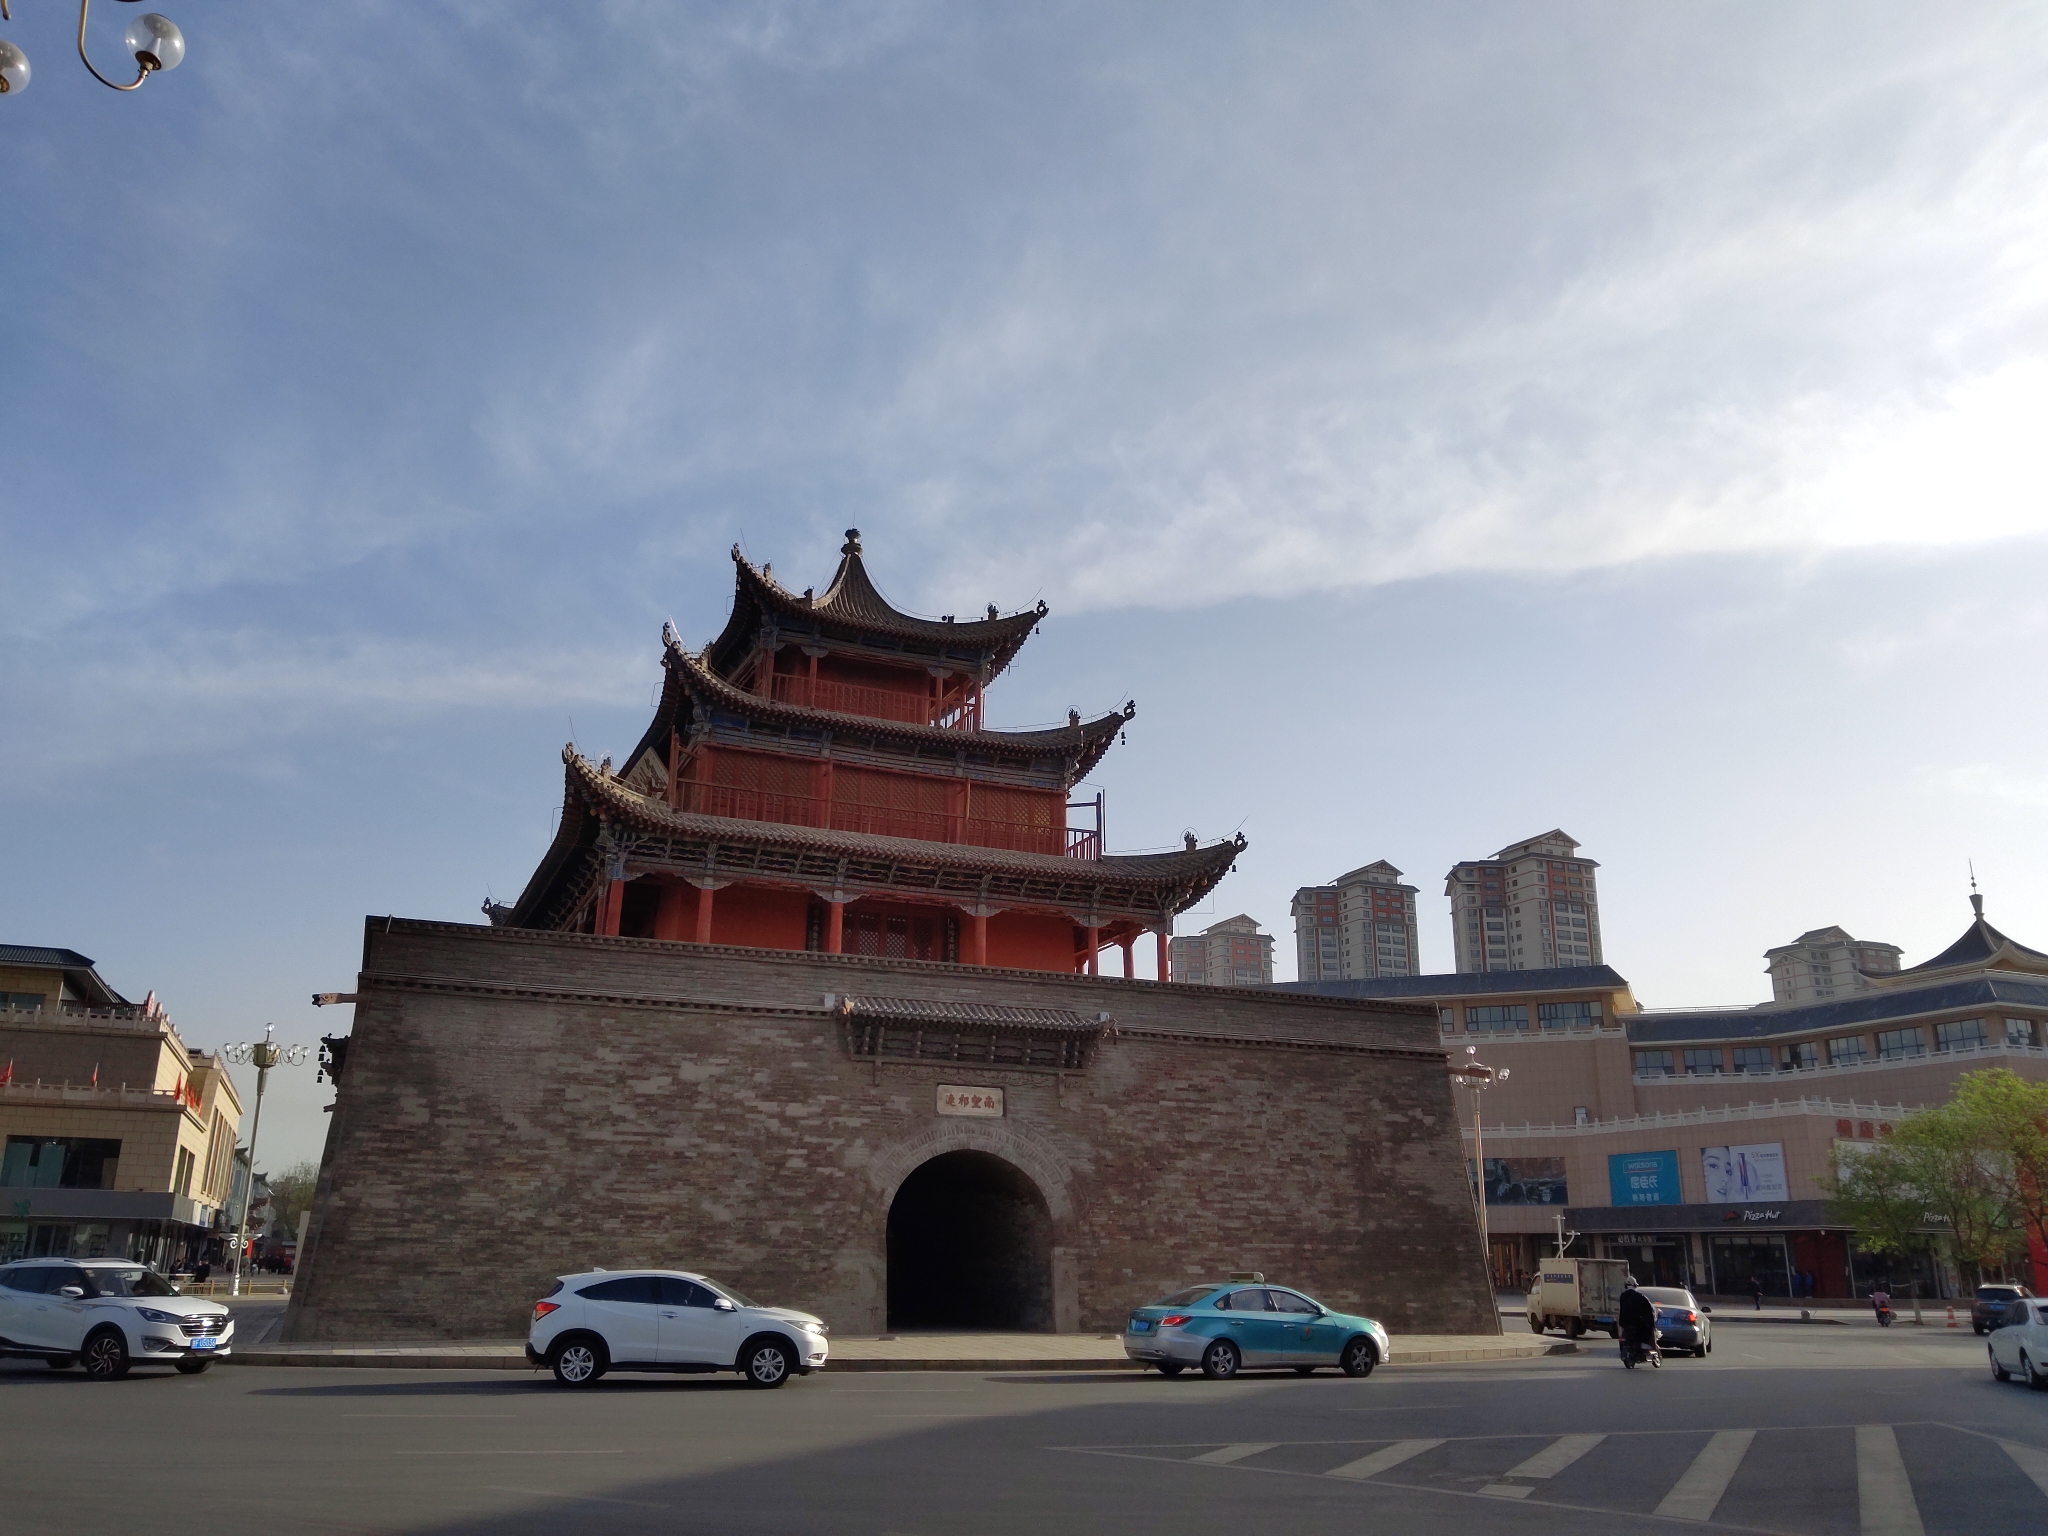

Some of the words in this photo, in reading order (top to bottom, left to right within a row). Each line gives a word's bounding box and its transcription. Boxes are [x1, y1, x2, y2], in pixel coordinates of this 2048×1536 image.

[1630, 1174, 1659, 1189] 屈臣氏
[1743, 1210, 1765, 1222] Pizza
[1765, 1209, 1782, 1220] Hut
[1923, 1211, 1943, 1223] Pizza
